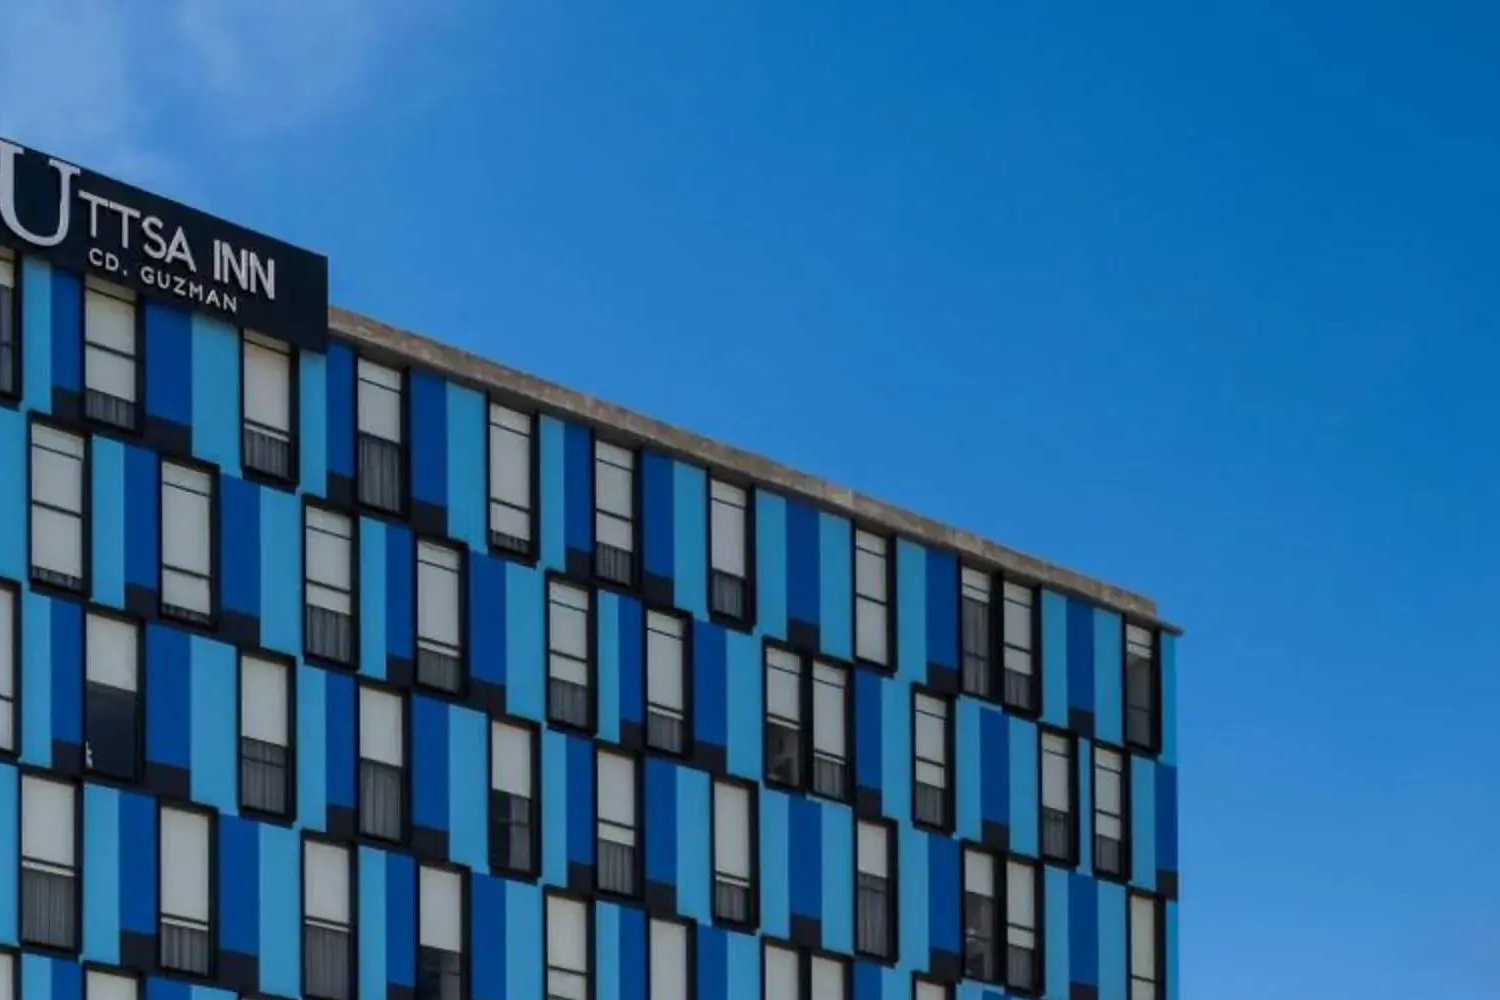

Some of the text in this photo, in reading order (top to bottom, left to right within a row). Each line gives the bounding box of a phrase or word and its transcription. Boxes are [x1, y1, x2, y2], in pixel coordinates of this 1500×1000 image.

[89, 247, 237, 313] CD. GUZMAN
[213, 239, 275, 300] INN
